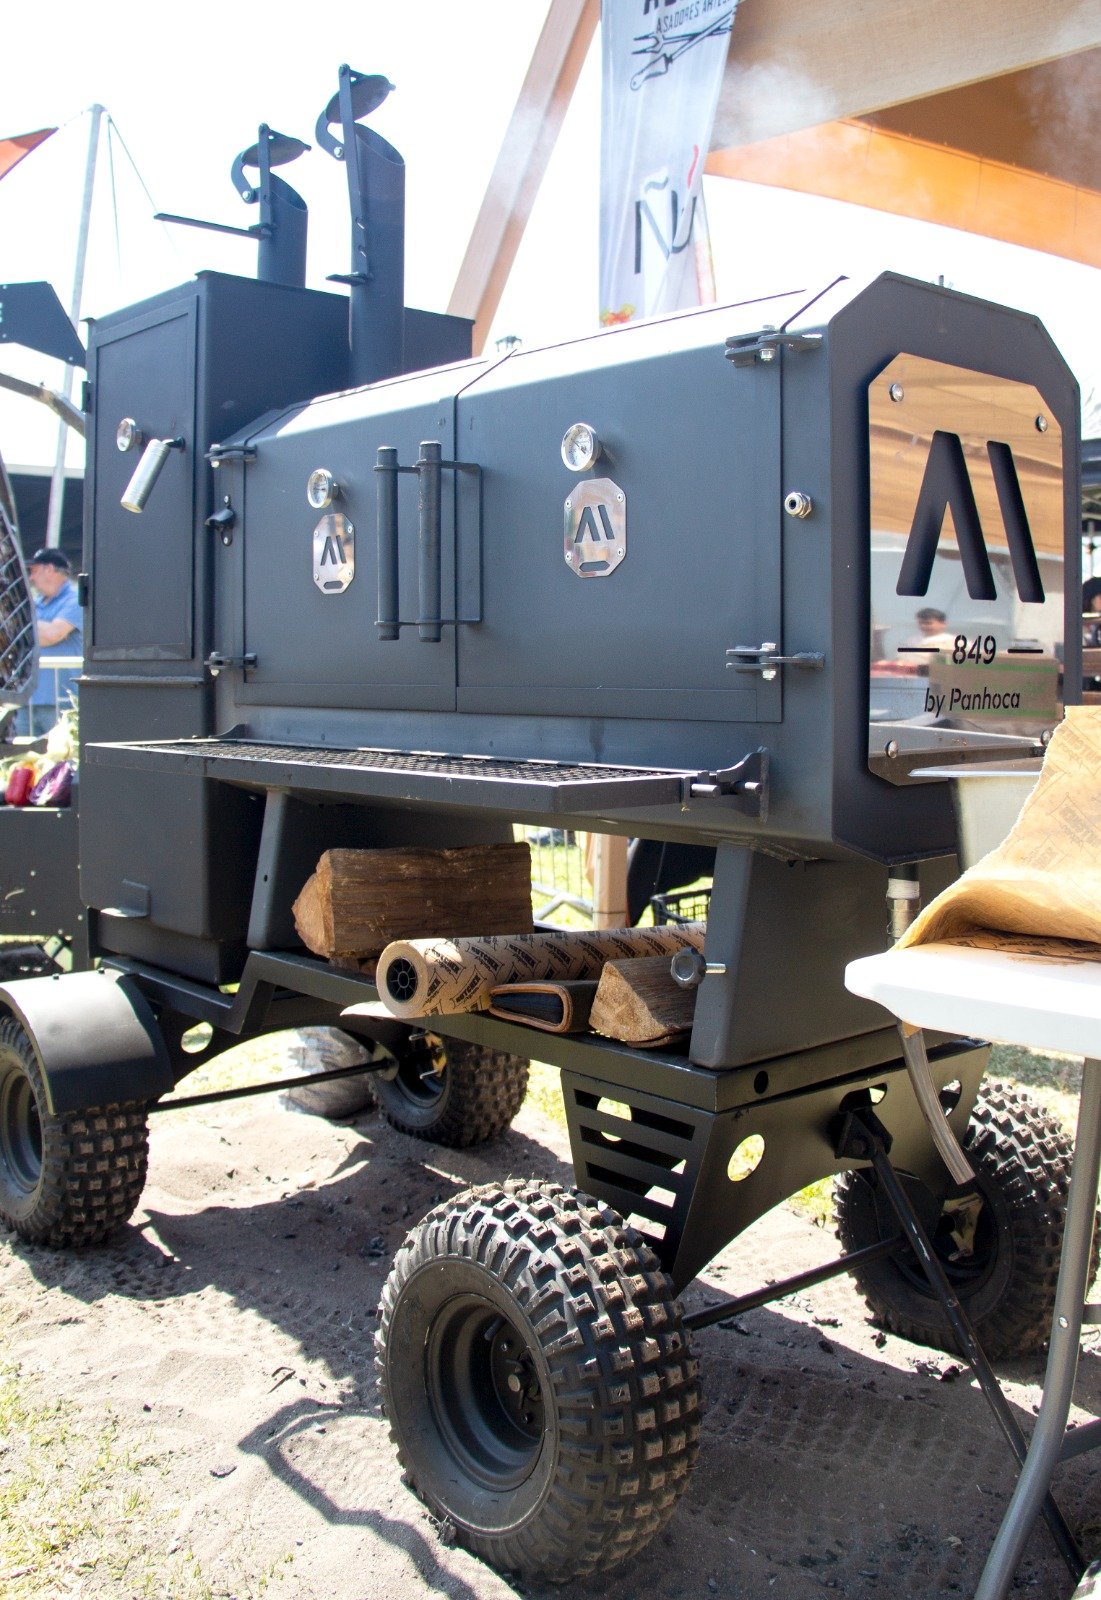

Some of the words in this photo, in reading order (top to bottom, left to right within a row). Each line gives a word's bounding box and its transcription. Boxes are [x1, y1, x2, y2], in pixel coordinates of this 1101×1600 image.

[952, 634, 997, 665] 849
[923, 687, 945, 718] by
[949, 686, 1021, 711] Panhoca
